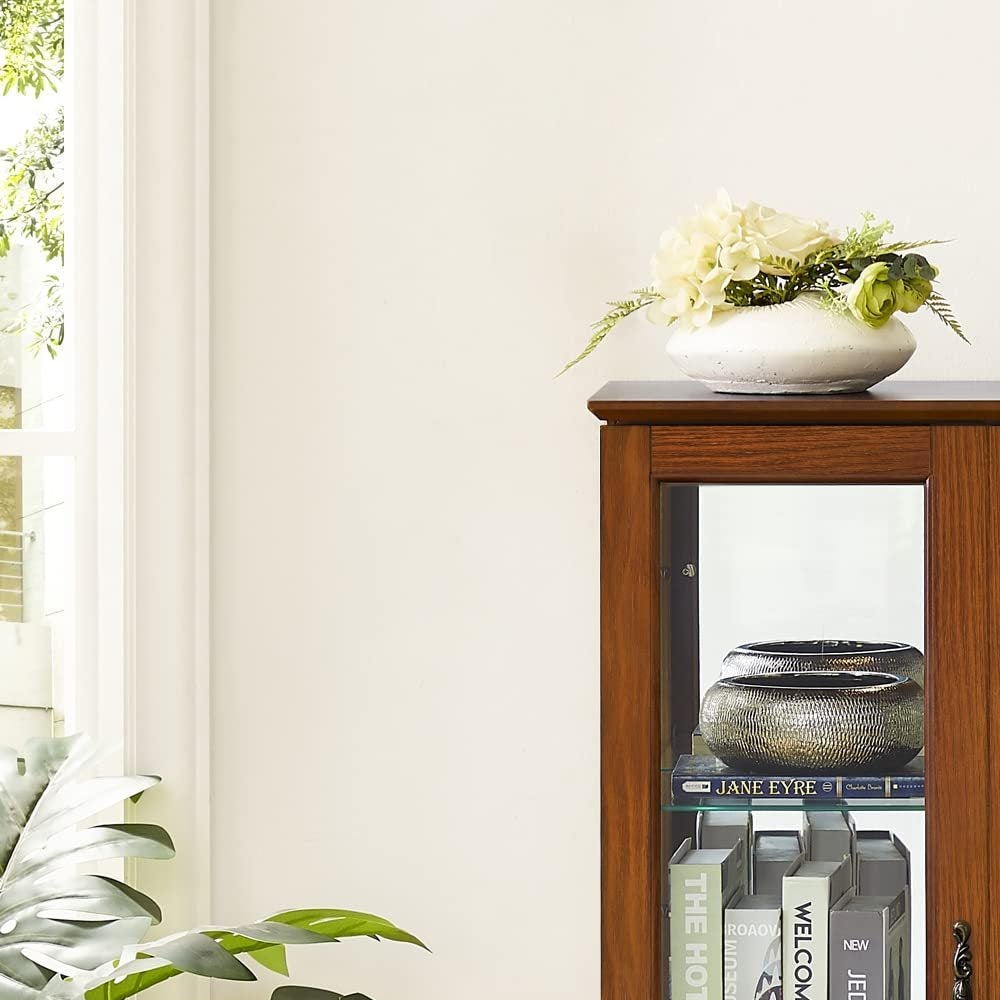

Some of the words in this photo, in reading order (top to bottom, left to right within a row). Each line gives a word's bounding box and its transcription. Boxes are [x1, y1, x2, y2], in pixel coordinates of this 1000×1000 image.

[715, 780, 764, 795] JANE
[768, 778, 817, 796] EYRE
[684, 872, 707, 934] THE
[843, 938, 870, 951] NEW
